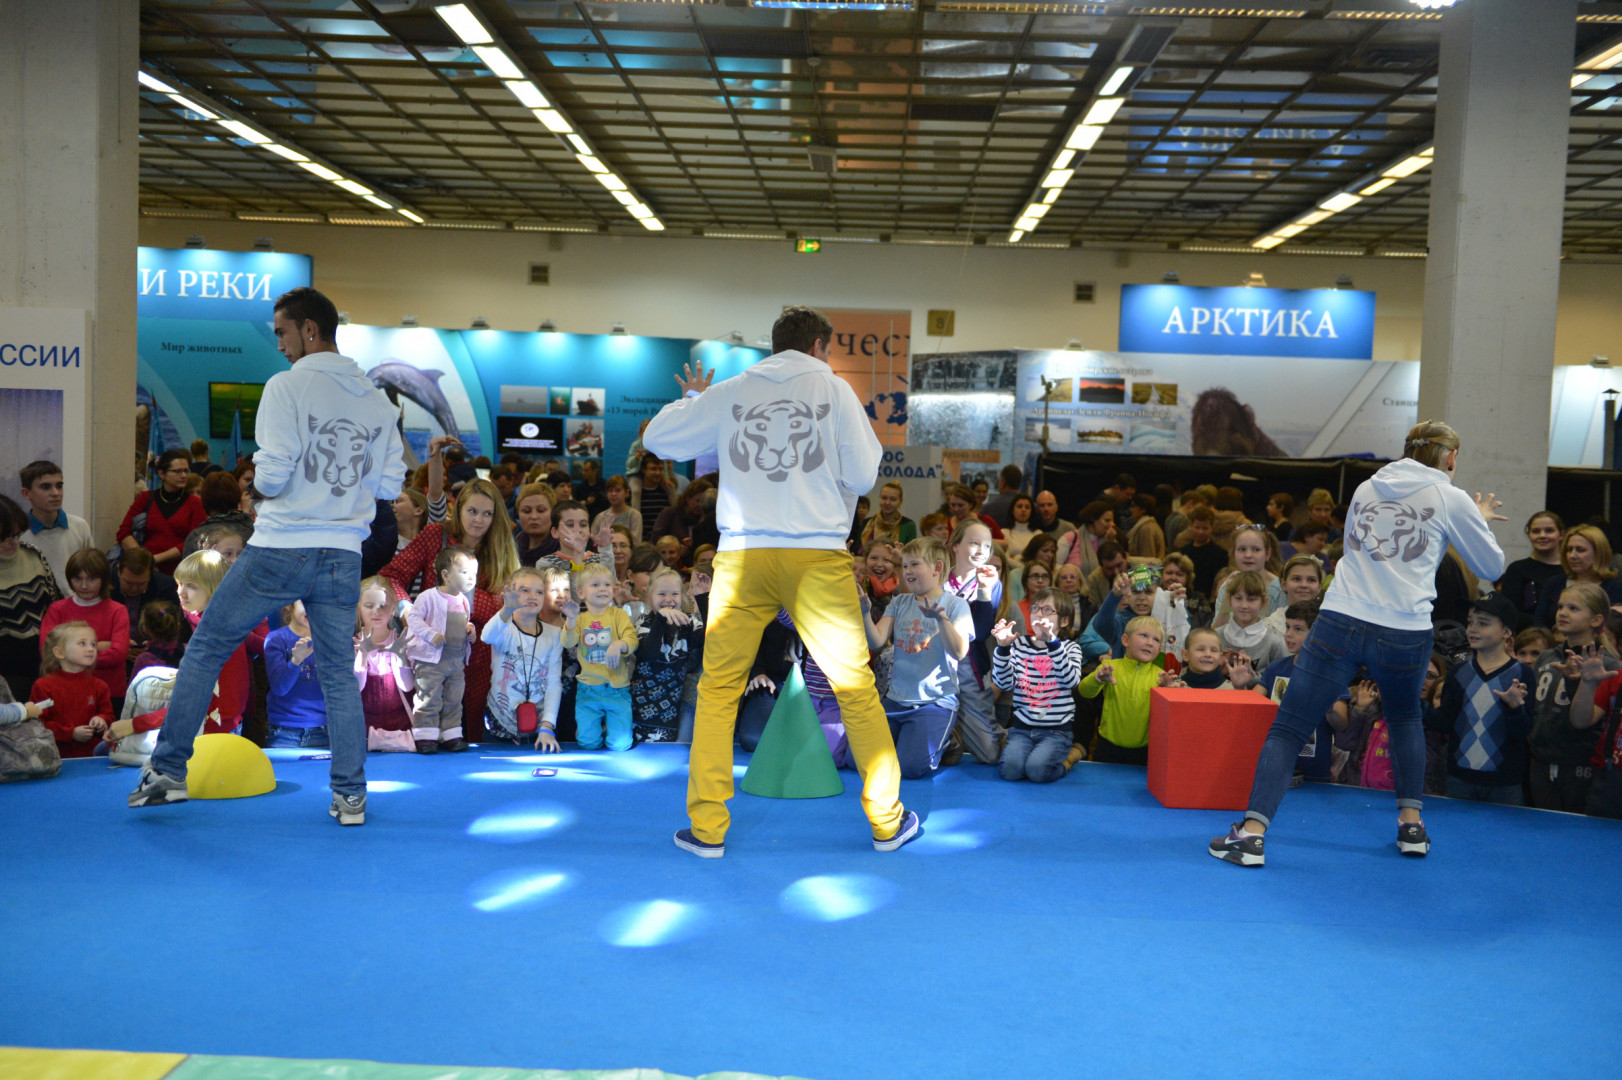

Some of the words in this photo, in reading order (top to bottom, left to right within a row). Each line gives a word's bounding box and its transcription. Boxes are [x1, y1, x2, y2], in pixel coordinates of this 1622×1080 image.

[139, 267, 168, 297] И
[176, 269, 273, 302] РЕКИ
[935, 317, 945, 329] 8
[1161, 305, 1338, 338] АРКТИКА
[161, 341, 186, 354] Мир
[187, 344, 243, 354] животных
[1031, 406, 1075, 417] Арипелаг
[1575, 766, 1592, 778] 86
